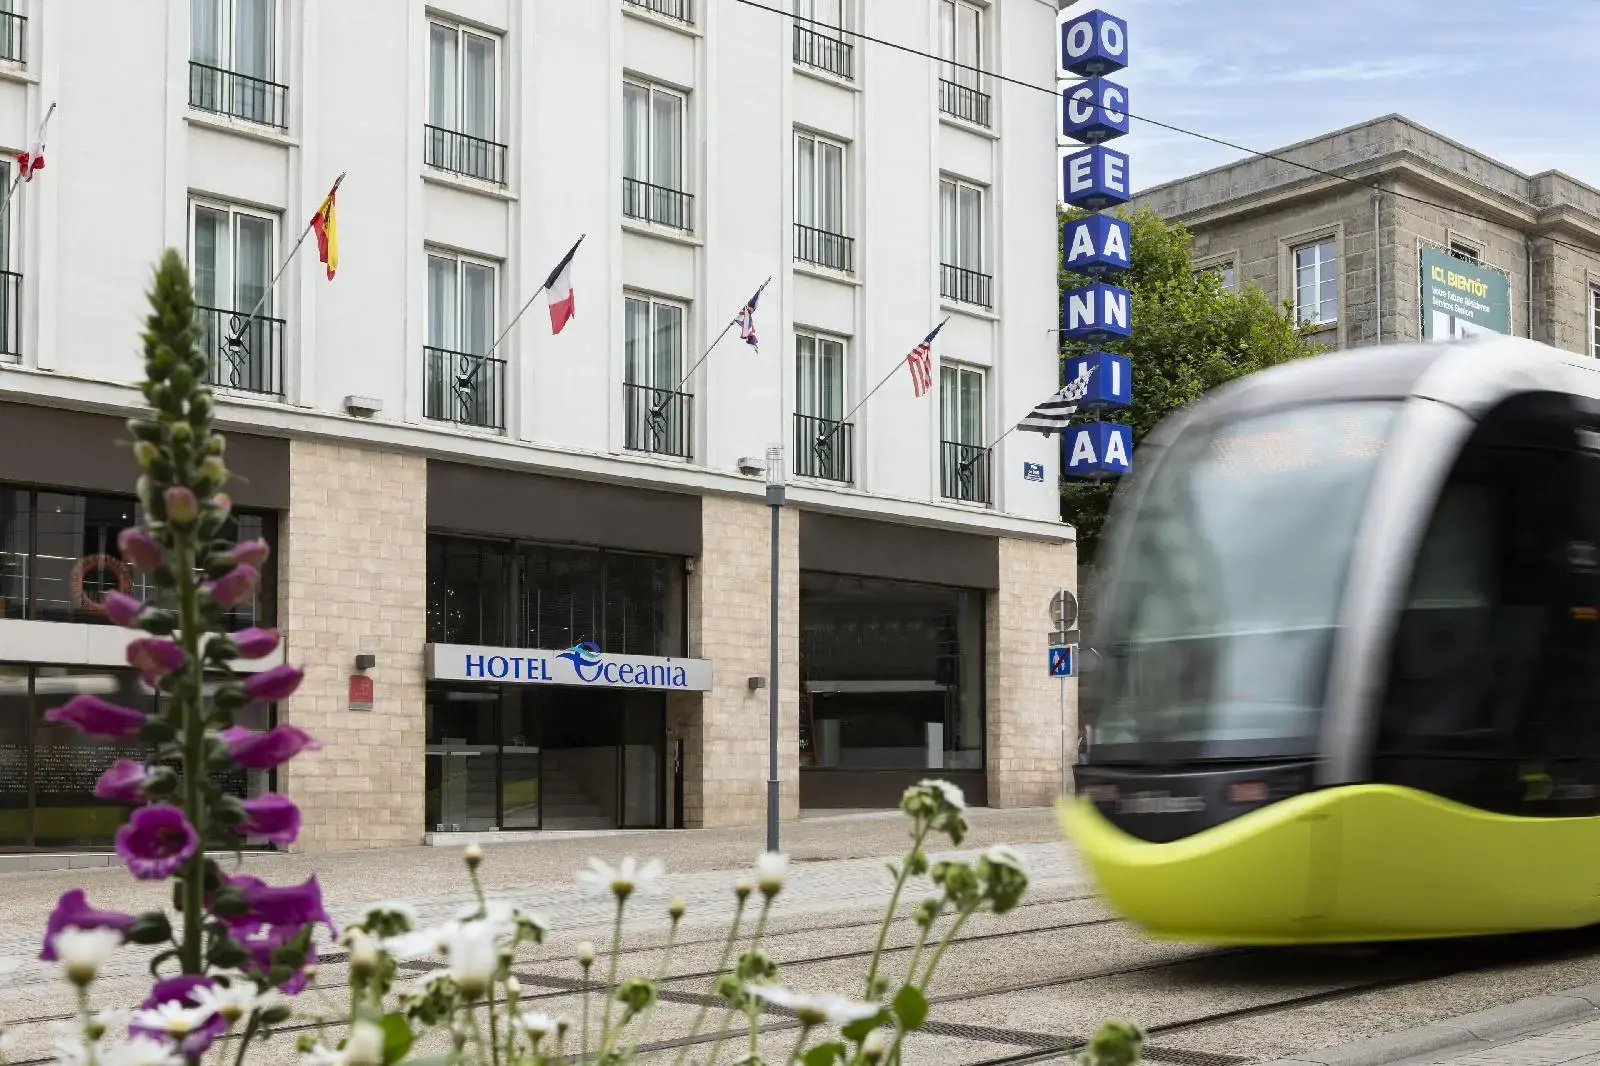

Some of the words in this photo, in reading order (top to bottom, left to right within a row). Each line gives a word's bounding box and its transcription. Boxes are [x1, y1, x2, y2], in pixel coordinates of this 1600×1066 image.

[1100, 19, 1129, 467] OCEANIA
[1447, 270, 1488, 299] BIENTÔT
[1432, 296, 1454, 311] Services
[465, 654, 552, 681] HOTEL
[556, 641, 688, 687] Oceania
